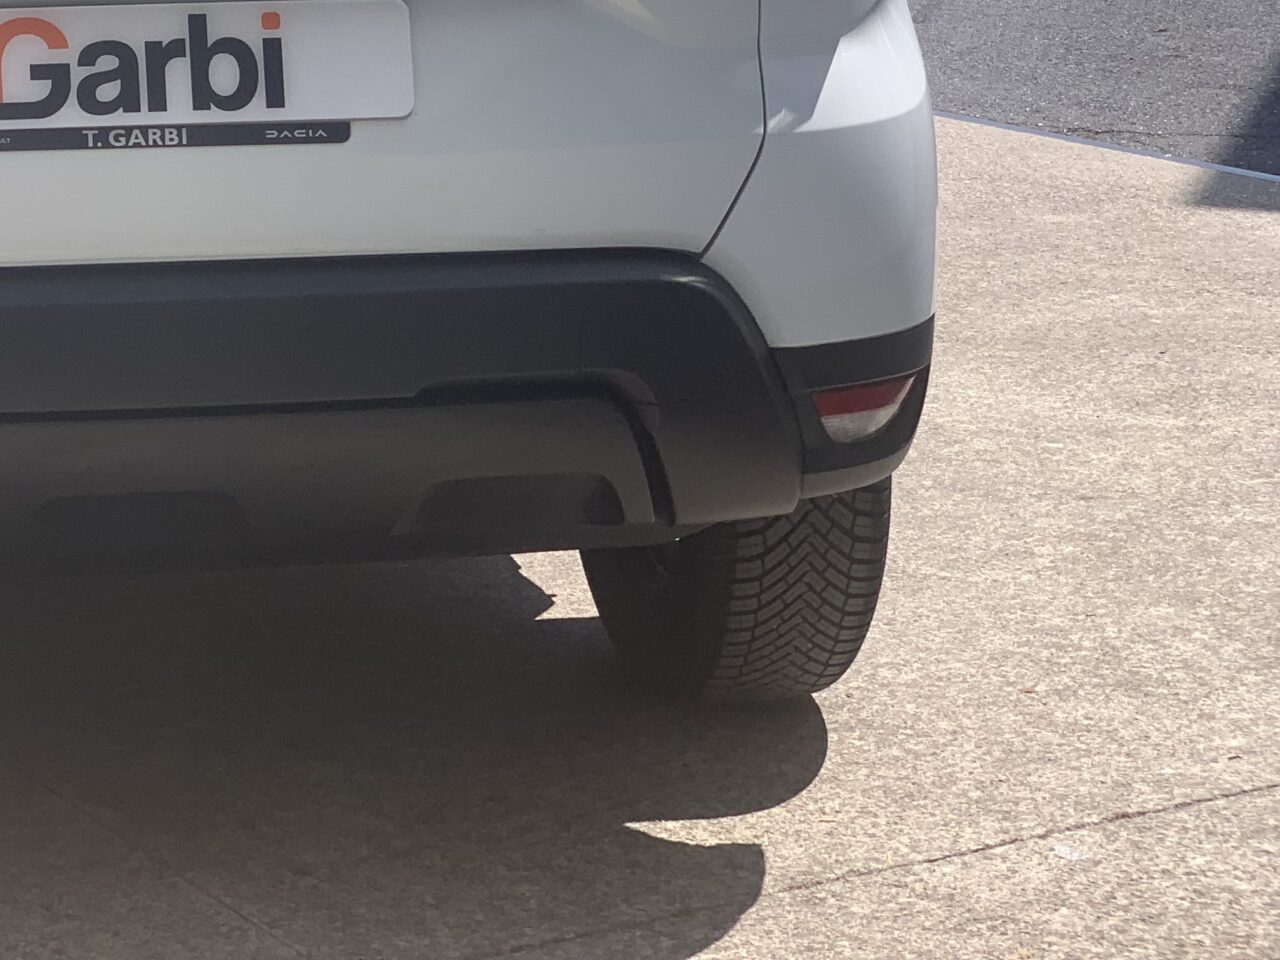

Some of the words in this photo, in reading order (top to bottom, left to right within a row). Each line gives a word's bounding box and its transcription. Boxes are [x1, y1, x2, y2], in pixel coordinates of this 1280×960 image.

[81, 129, 102, 148] T.
[108, 127, 188, 147] GARBI
[265, 129, 328, 138] DACIA
